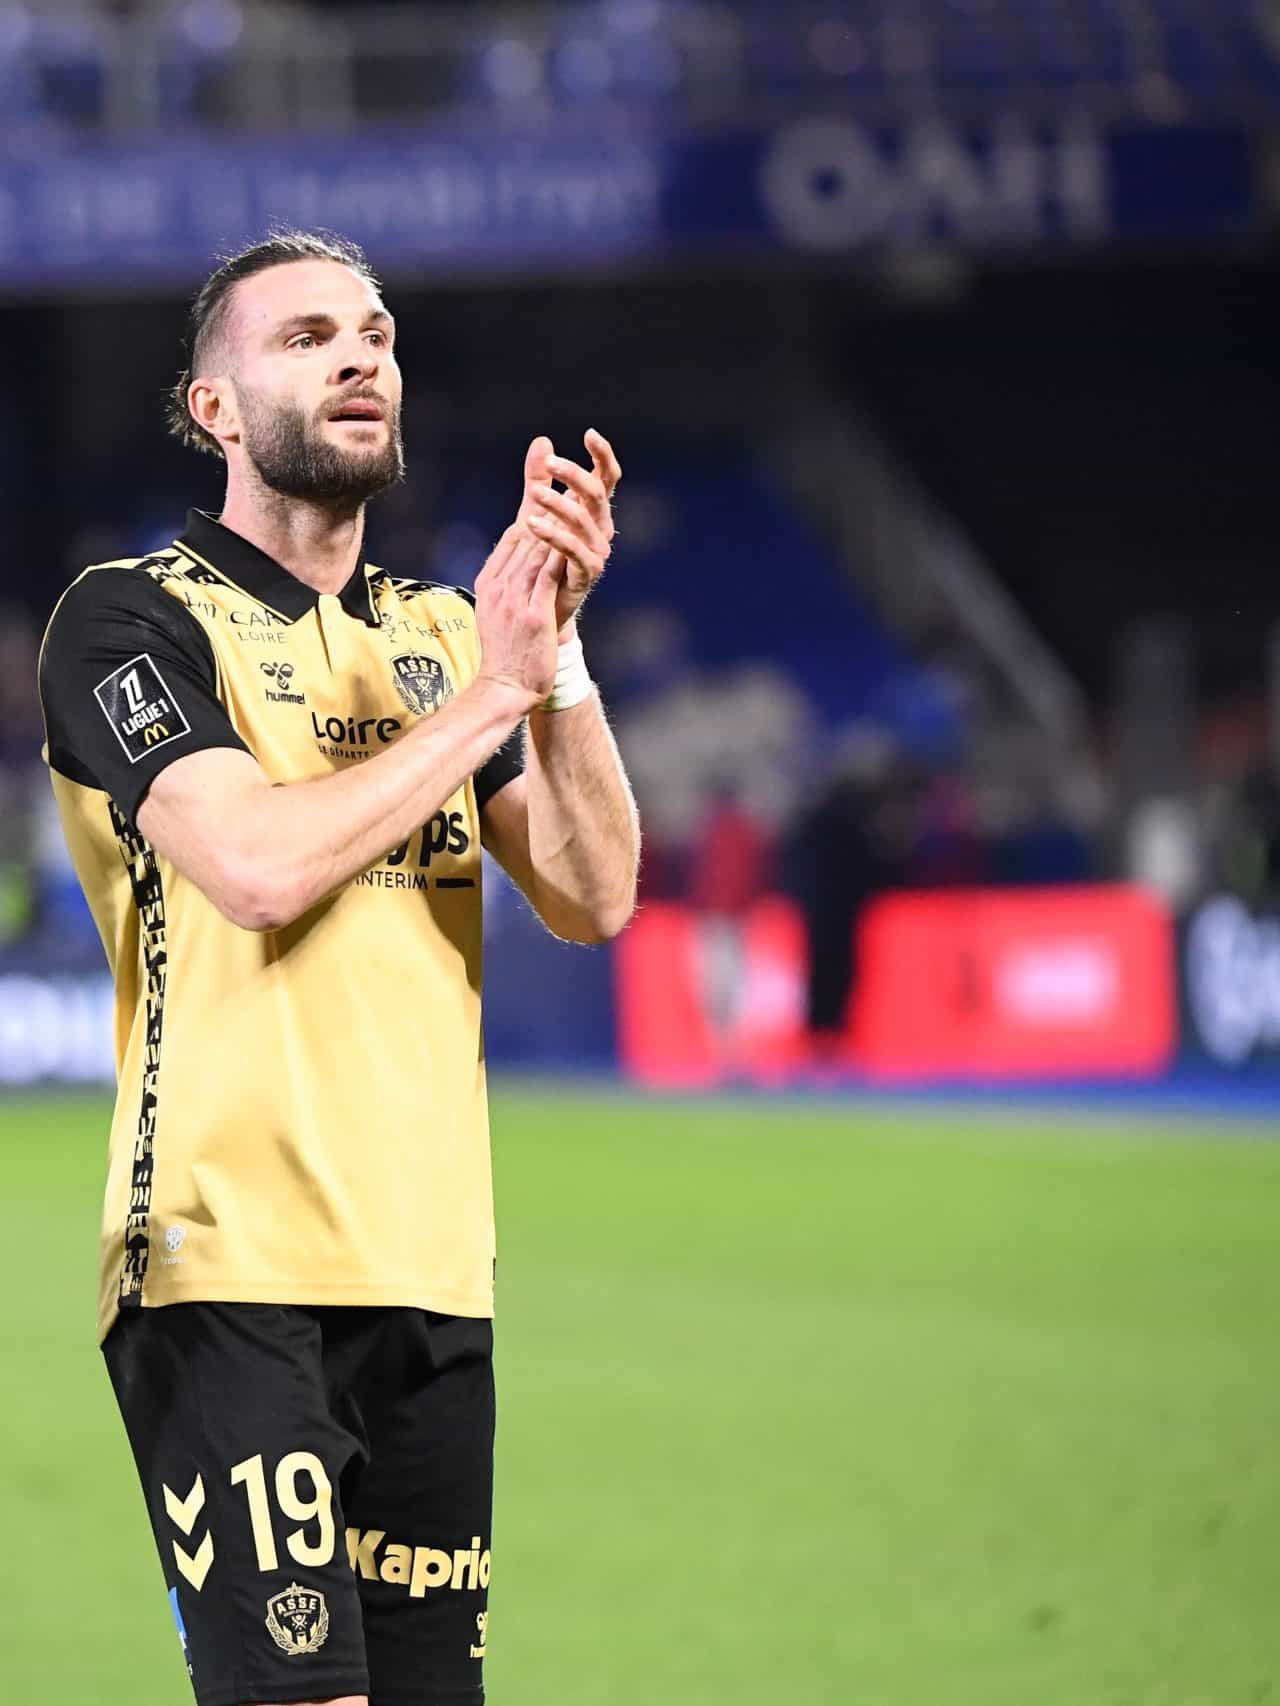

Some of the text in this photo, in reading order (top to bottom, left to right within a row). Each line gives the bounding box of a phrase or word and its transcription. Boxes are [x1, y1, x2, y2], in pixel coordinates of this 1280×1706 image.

[398, 660, 440, 676] ASSE
[265, 689, 305, 705] hummel
[312, 711, 402, 745] Loire
[230, 1451, 336, 1573] 19
[277, 1597, 318, 1614] ASSE
